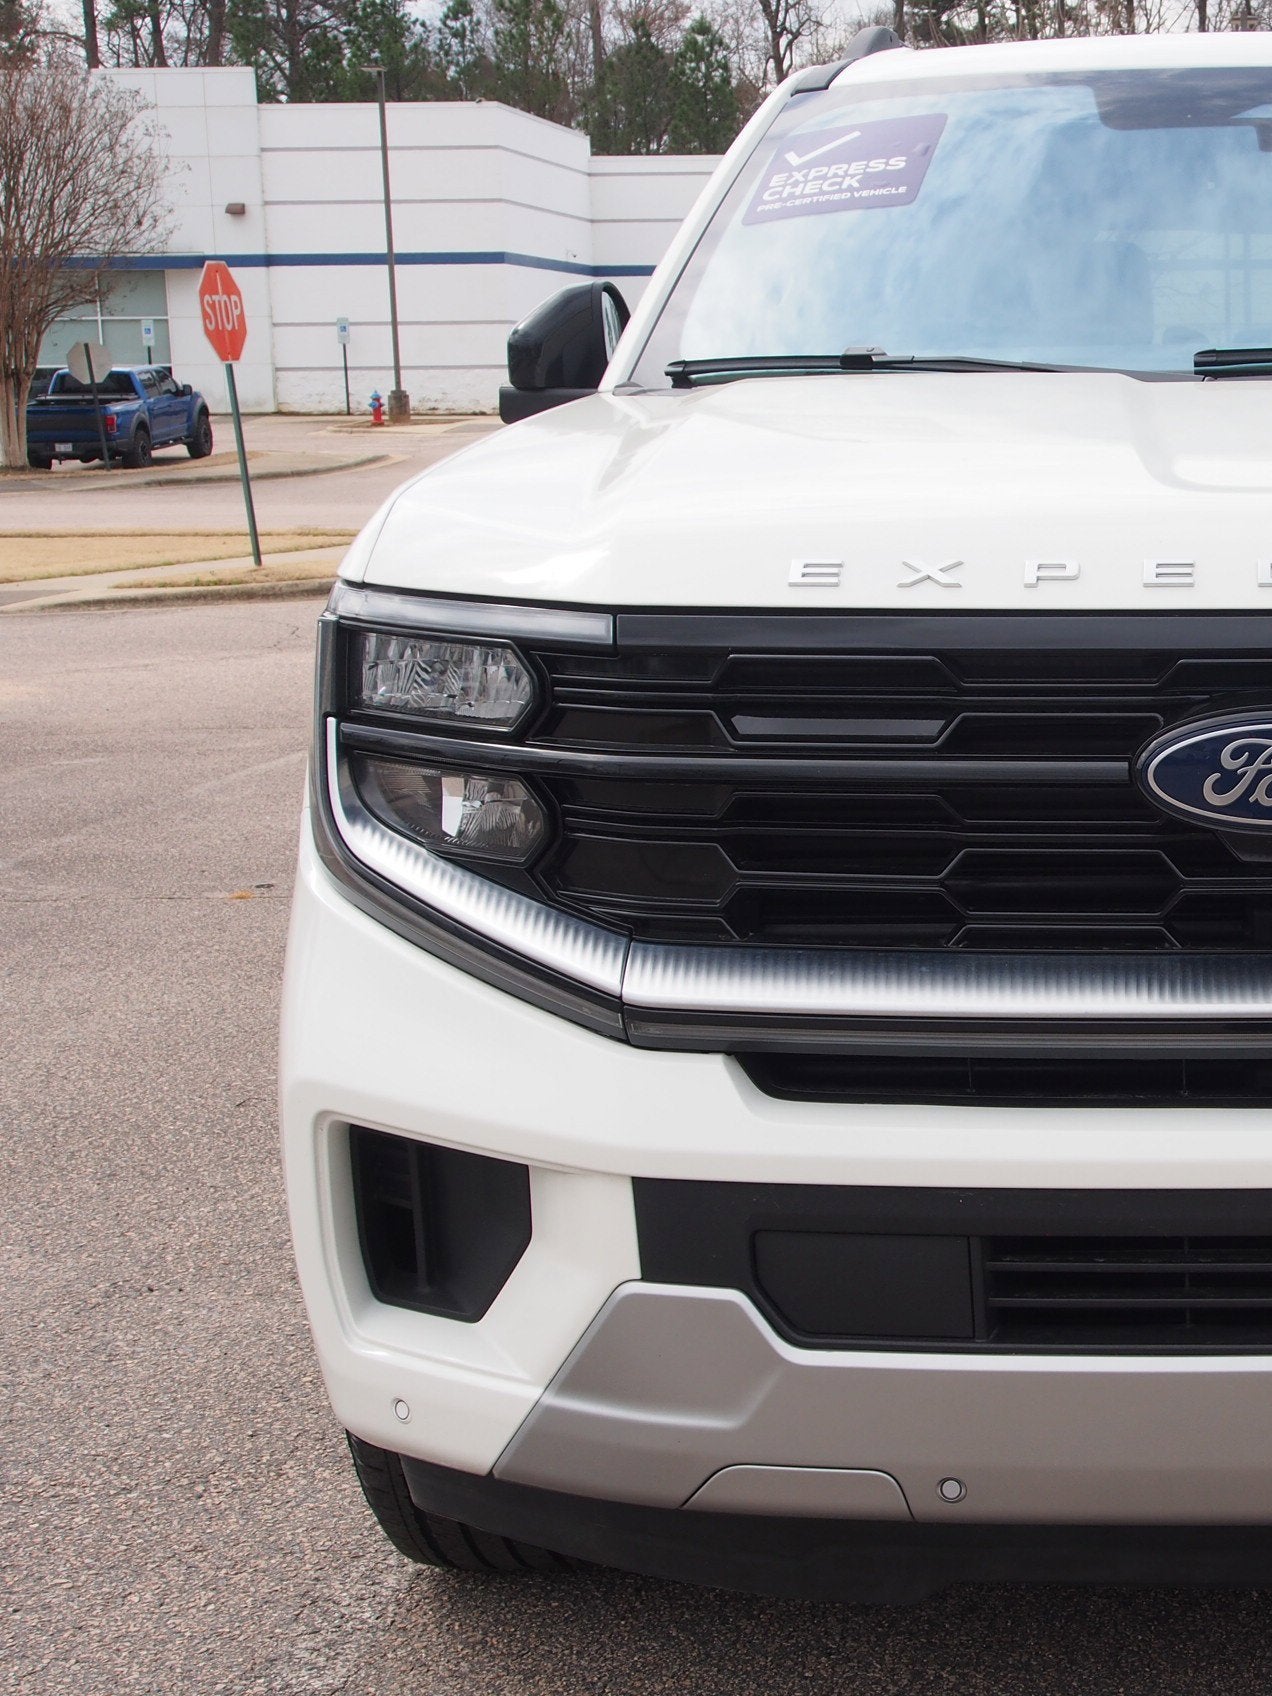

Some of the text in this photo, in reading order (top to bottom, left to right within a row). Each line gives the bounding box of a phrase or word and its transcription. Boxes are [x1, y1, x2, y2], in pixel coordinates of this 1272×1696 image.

[769, 156, 907, 187] EXPRESS
[757, 186, 907, 212] PRE-CERTIFIED VEHICLE
[762, 174, 863, 201] CHECK
[203, 294, 241, 331] STOP
